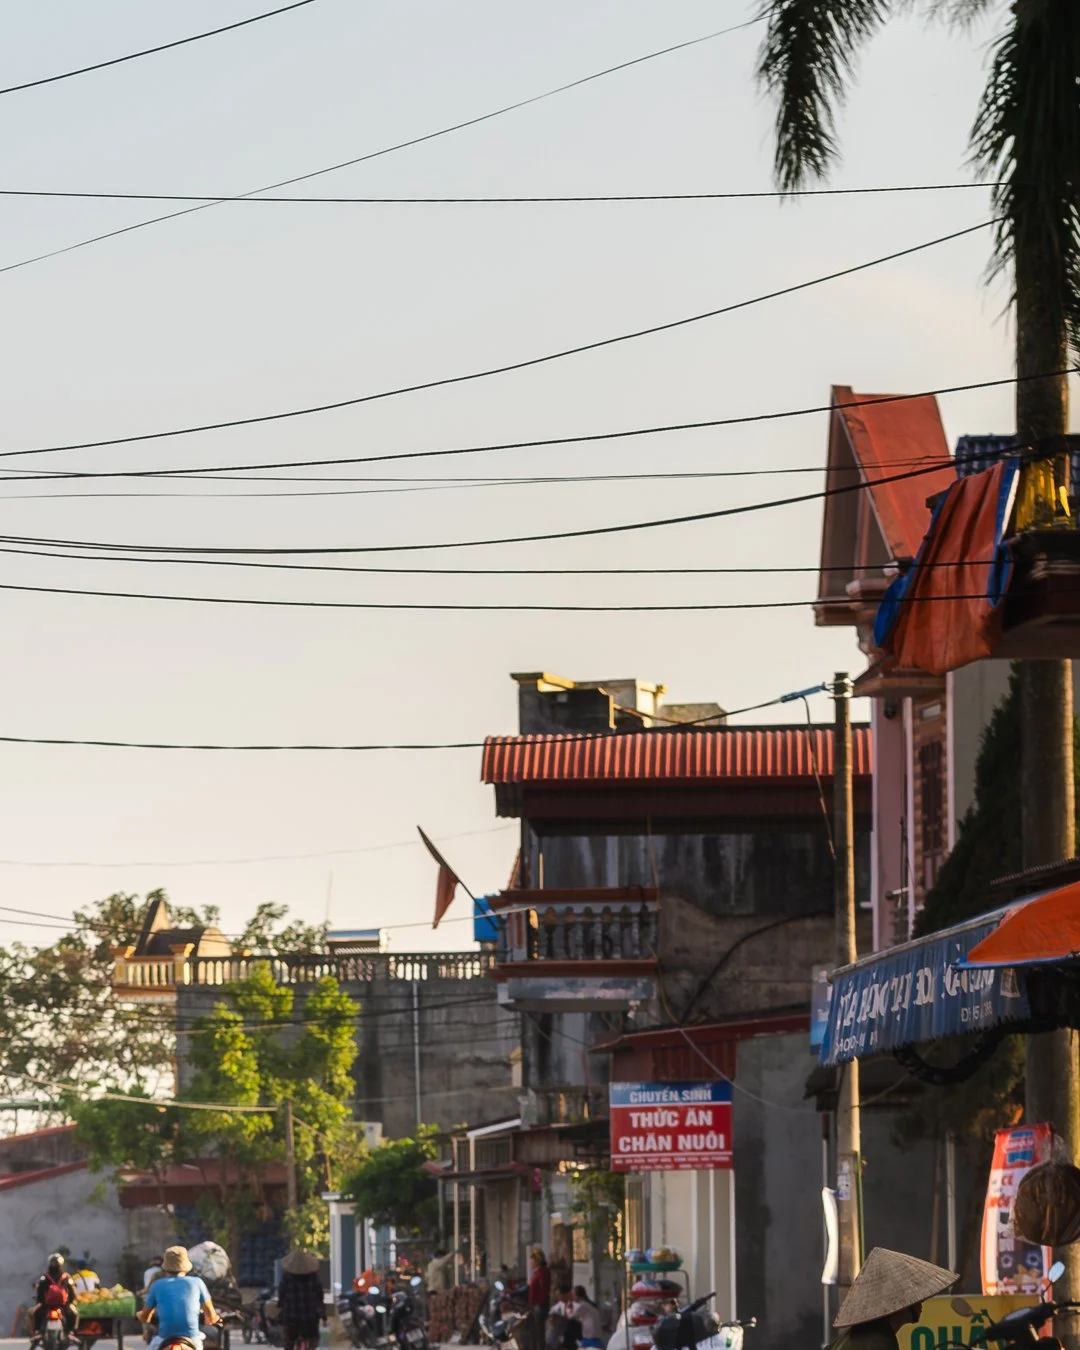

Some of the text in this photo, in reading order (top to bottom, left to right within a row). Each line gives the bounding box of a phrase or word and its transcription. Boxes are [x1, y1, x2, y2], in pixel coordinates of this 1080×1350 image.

[682, 1088, 712, 1101] SINH
[629, 1107, 713, 1128] THỨC ĂN
[618, 1130, 725, 1152] CHĂN NUÔI
